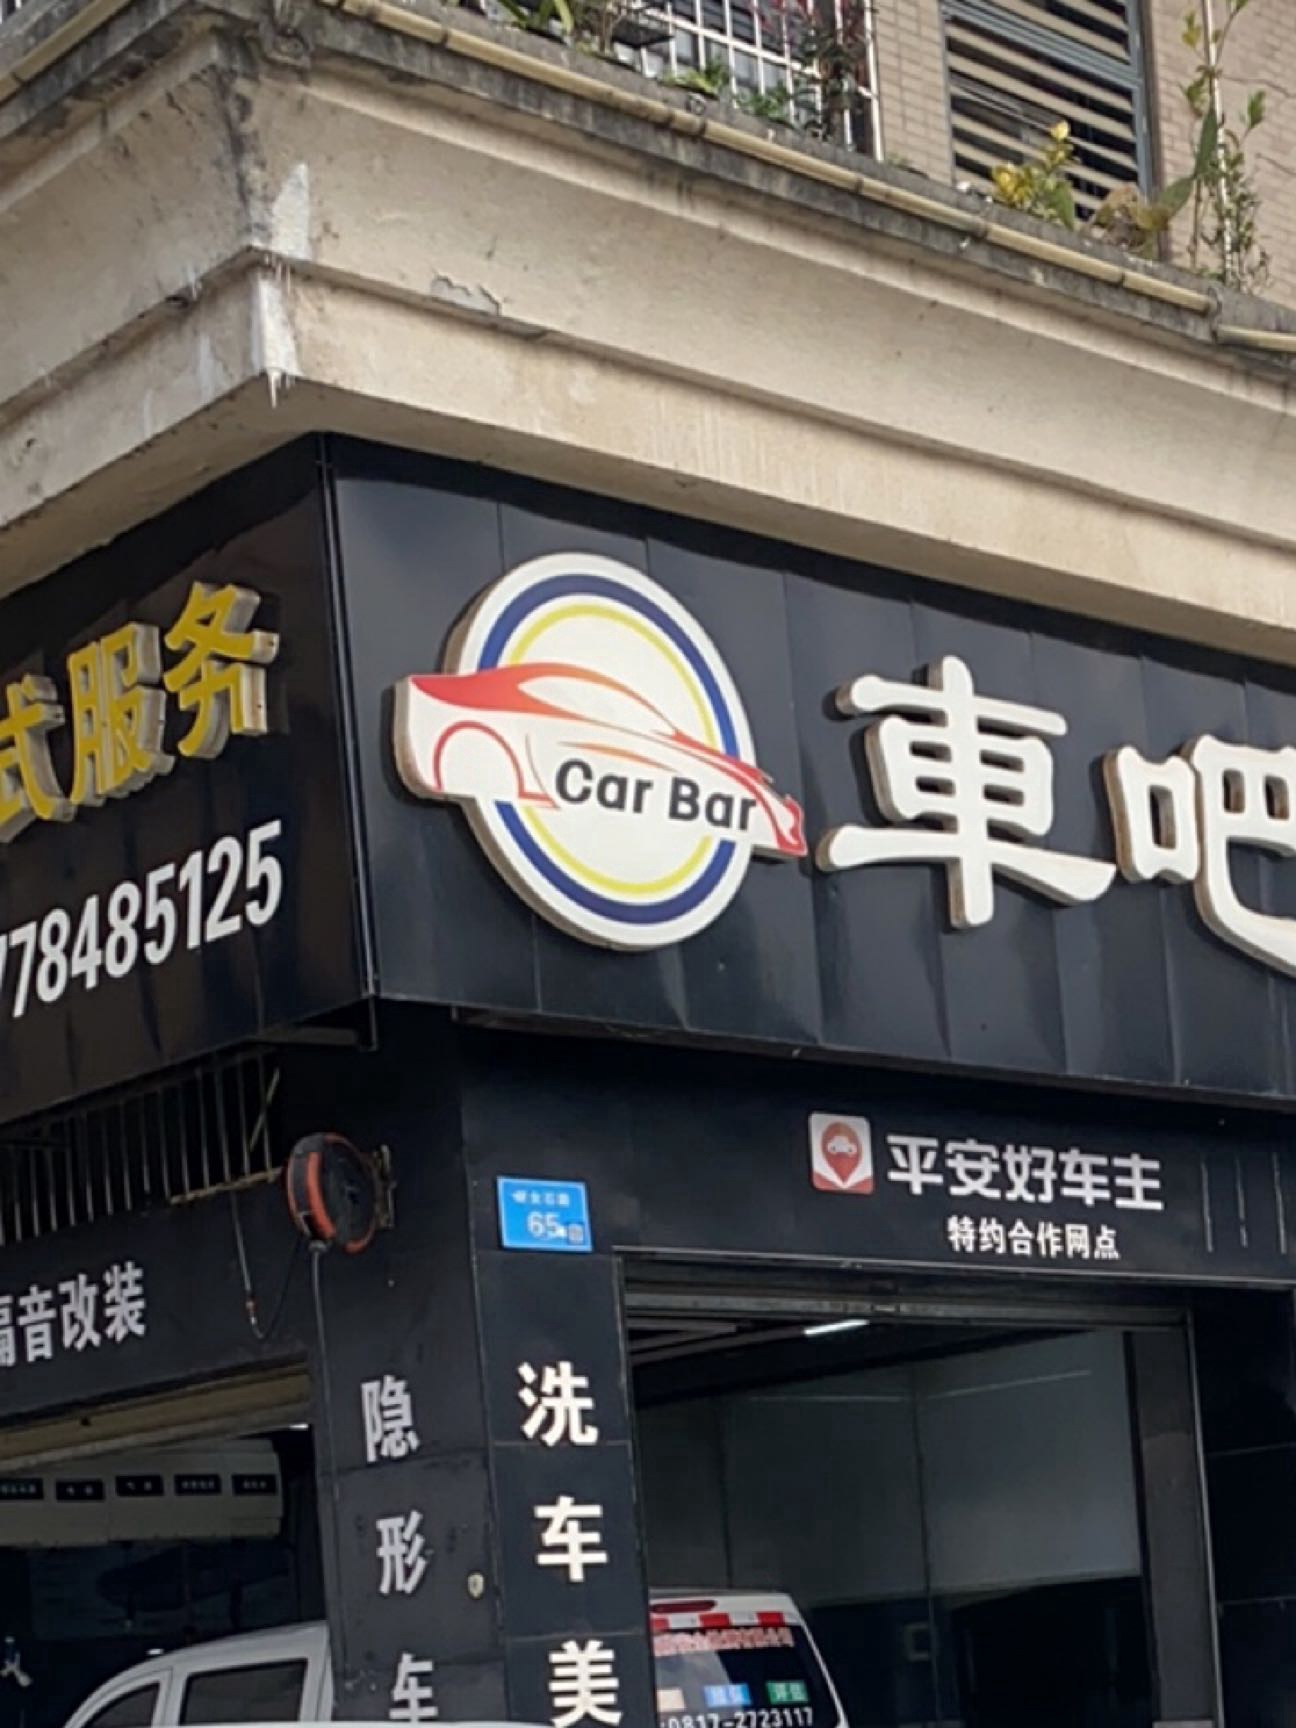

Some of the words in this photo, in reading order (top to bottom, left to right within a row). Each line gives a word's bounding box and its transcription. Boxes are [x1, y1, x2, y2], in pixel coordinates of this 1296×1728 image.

[555, 758, 653, 813] Car
[668, 776, 757, 831] Bar
[0, 819, 282, 1018] 78485125
[886, 1134, 1165, 1211] 平安好车主
[946, 1214, 1120, 1260] 特约合作网点
[361, 1374, 438, 1722] 隐形车
[517, 1360, 623, 1728] 洗车美
